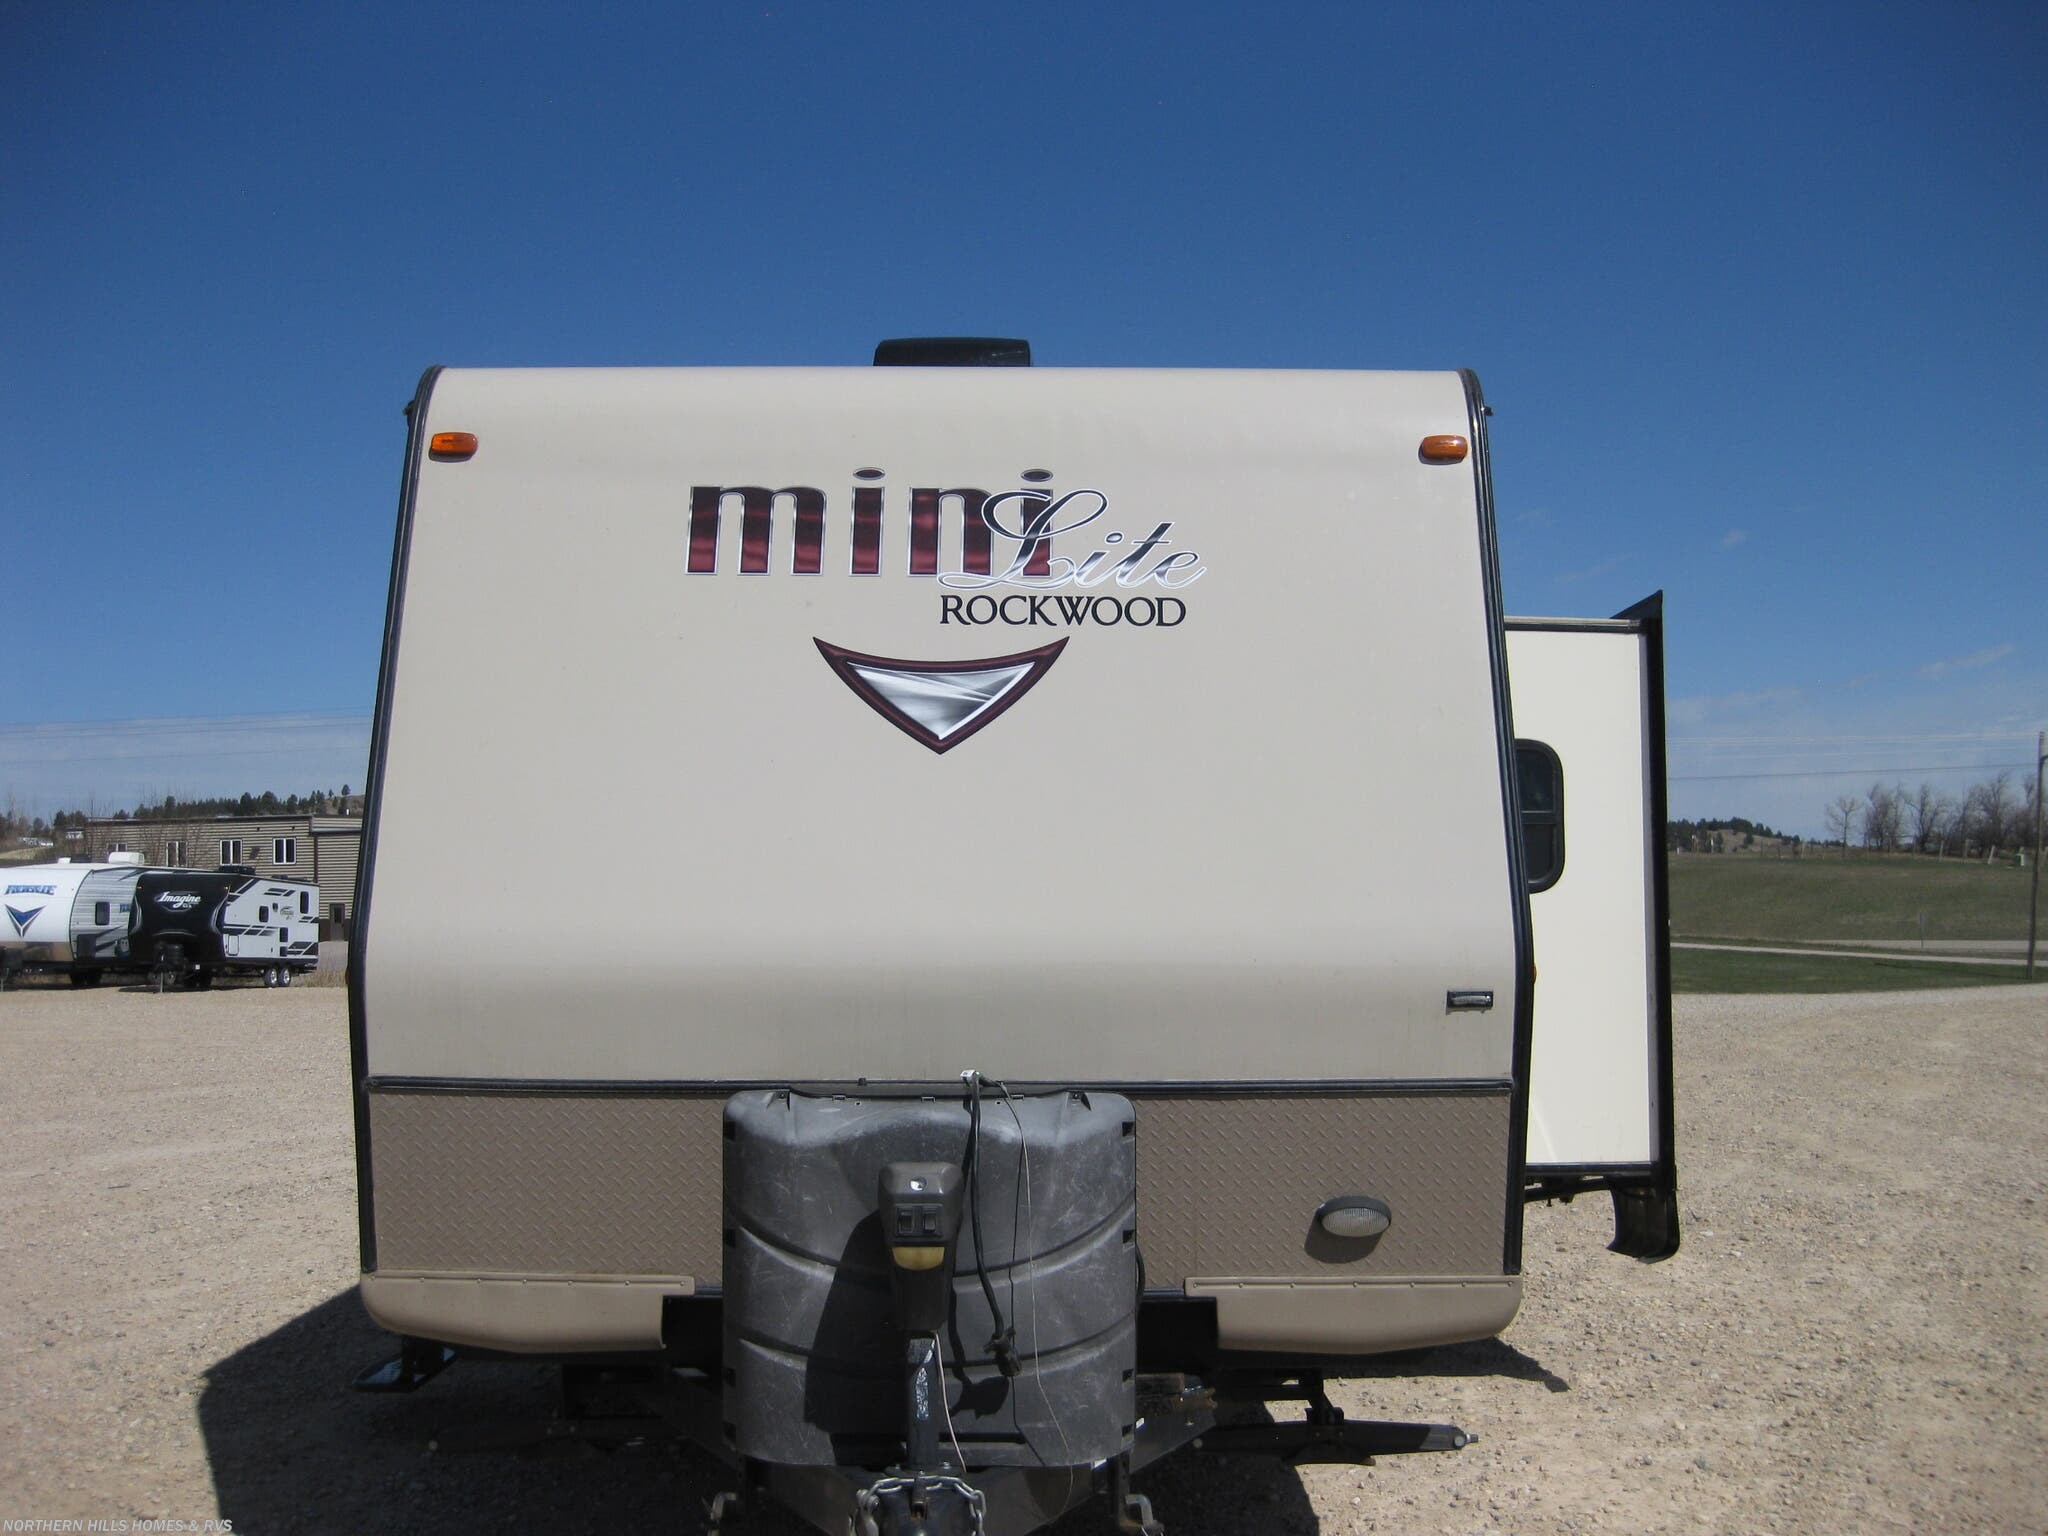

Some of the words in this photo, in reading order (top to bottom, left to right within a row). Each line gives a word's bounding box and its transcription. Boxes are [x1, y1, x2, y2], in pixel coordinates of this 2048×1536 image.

[685, 467, 1054, 577] mini
[938, 489, 1207, 589] Lite
[939, 595, 1187, 627] ROCKWOOD
[157, 891, 201, 908] Imagine
